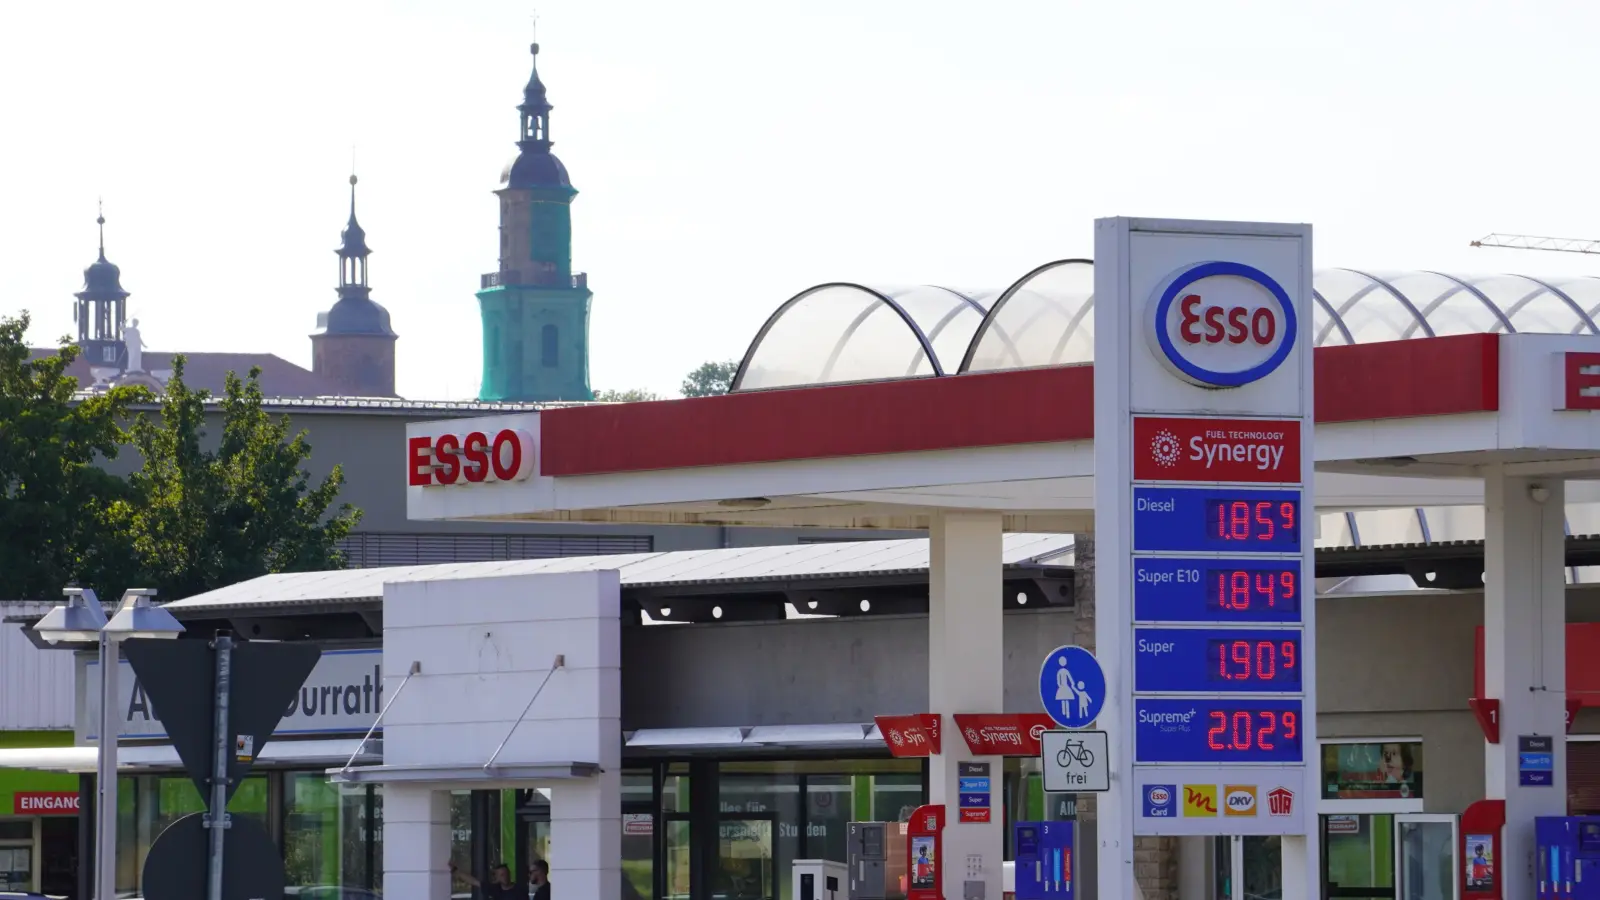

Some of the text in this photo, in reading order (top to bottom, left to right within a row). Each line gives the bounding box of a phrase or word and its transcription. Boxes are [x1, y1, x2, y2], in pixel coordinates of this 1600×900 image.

[1180, 294, 1276, 345] Esso
[1206, 430, 1285, 441] FUEL TECHNOLOGY
[409, 429, 522, 485] ESSO
[1189, 436, 1285, 470] Synergy
[1137, 498, 1175, 512] Diesel
[1137, 569, 1174, 585] Super
[1177, 569, 1200, 583] E10
[1138, 639, 1175, 656] Super
[1489, 710, 1496, 723] 1
[932, 719, 937, 728] 3
[932, 729, 937, 738] 5
[980, 729, 1021, 744] Synergy
[1066, 772, 1087, 784] frei
[1229, 797, 1252, 806] DKV
[1269, 788, 1292, 815] UTA
[1151, 808, 1168, 816] Card
[779, 823, 826, 838] Studen
[851, 826, 856, 834] 5
[1044, 826, 1049, 834] 3
